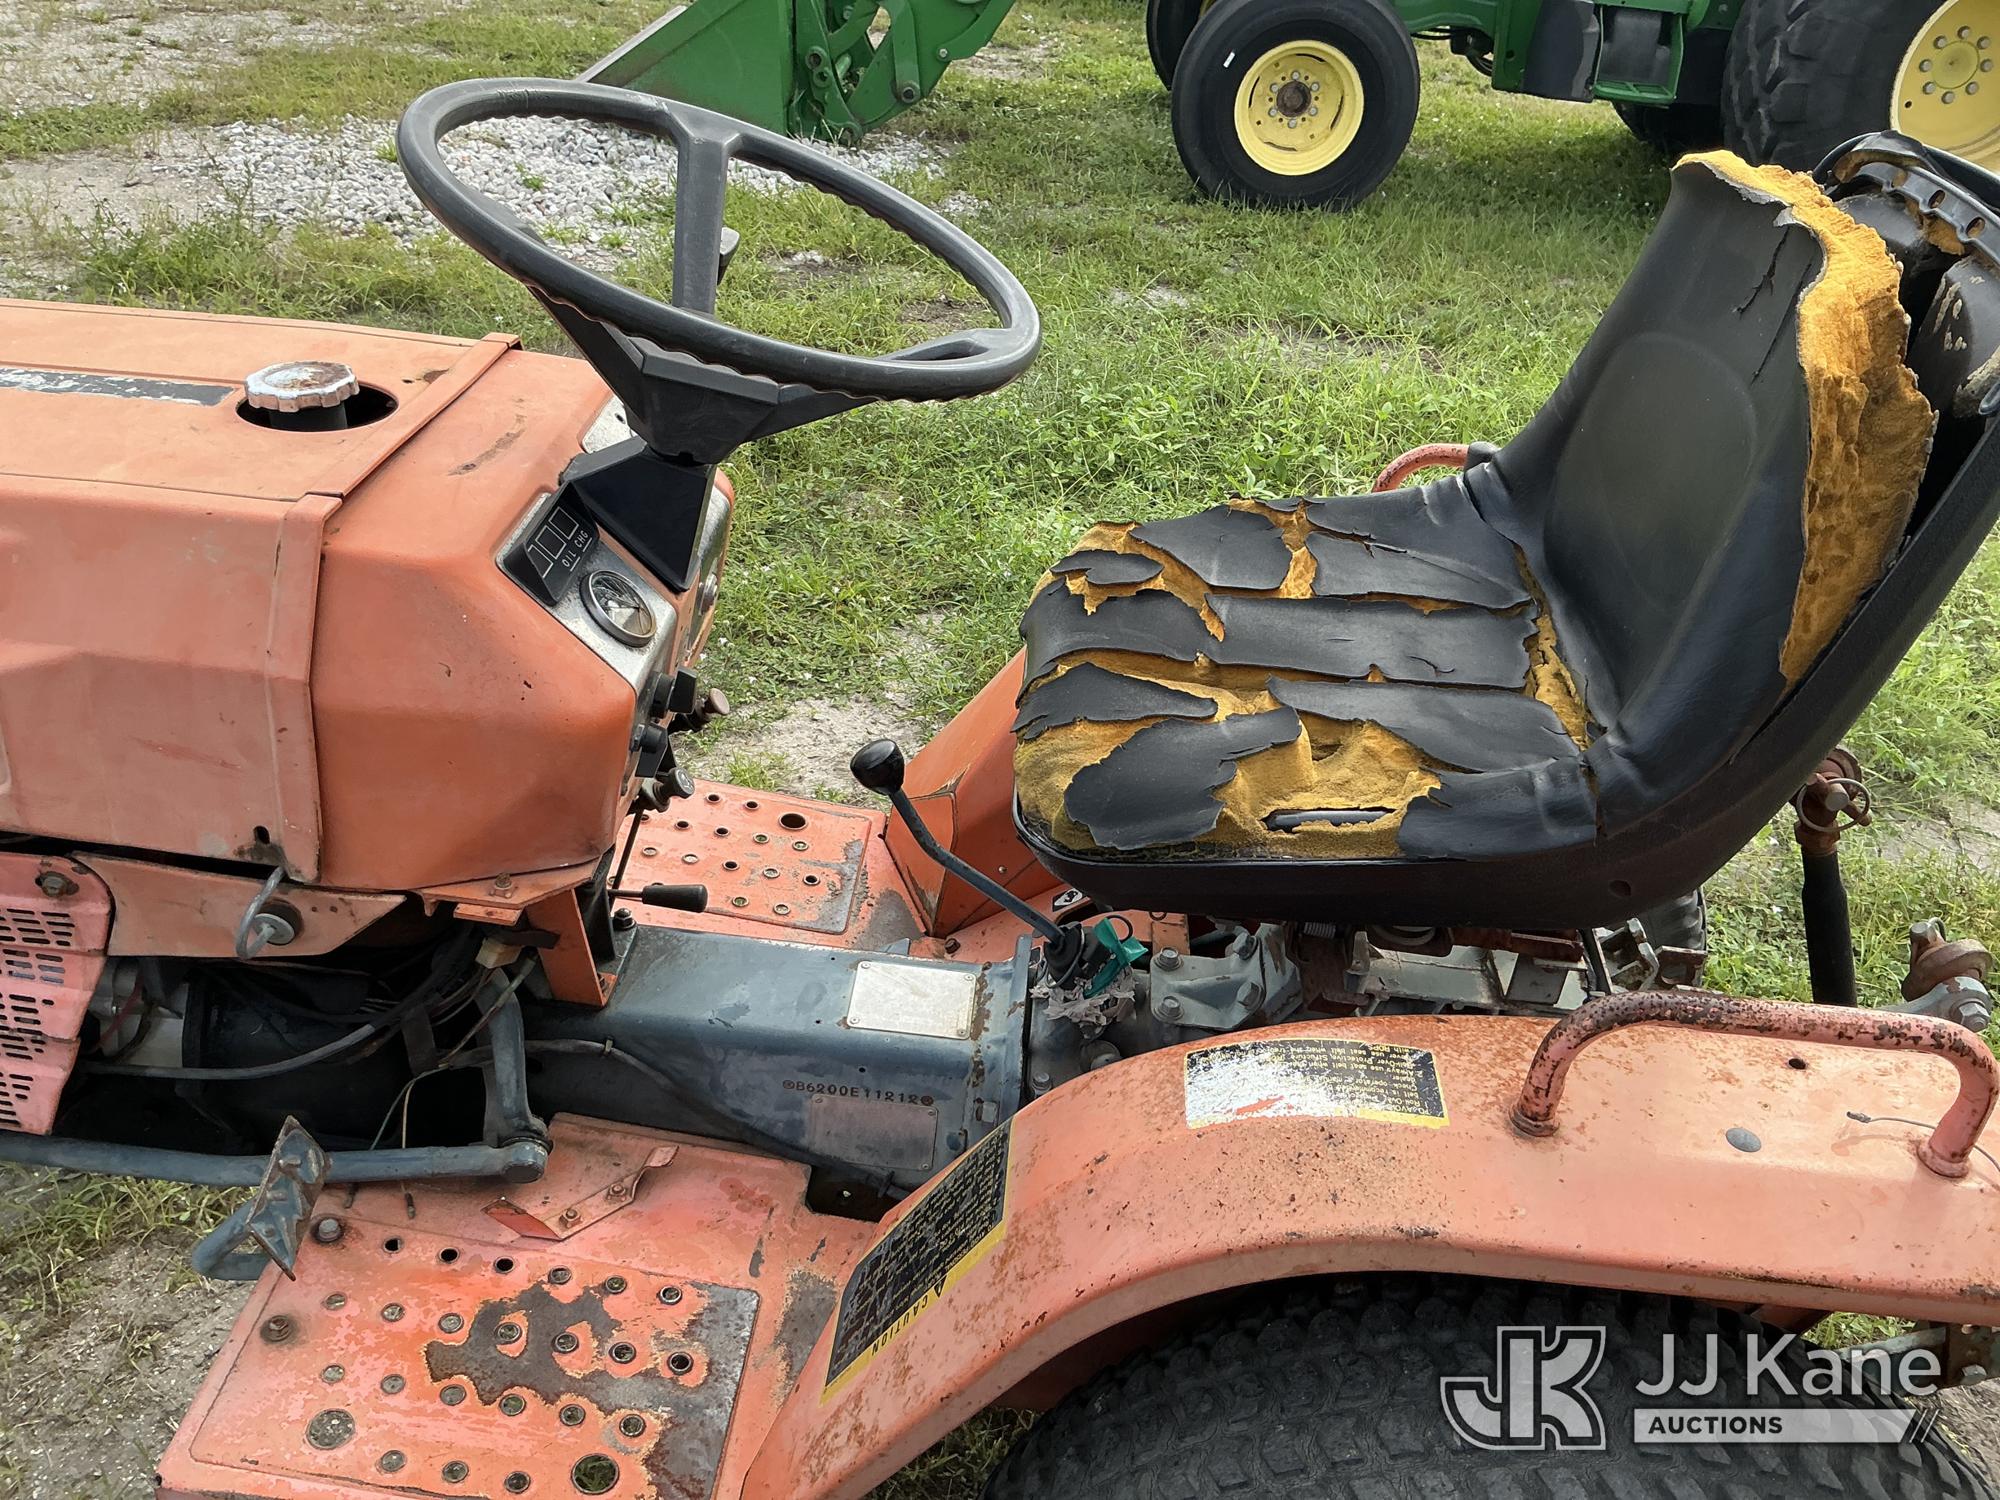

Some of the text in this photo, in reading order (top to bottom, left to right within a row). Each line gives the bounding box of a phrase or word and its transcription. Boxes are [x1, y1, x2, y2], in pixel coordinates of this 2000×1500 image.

[574, 530, 589, 548] CHG
[561, 551, 577, 568] OIL
[872, 1295, 928, 1356] CAUTION
